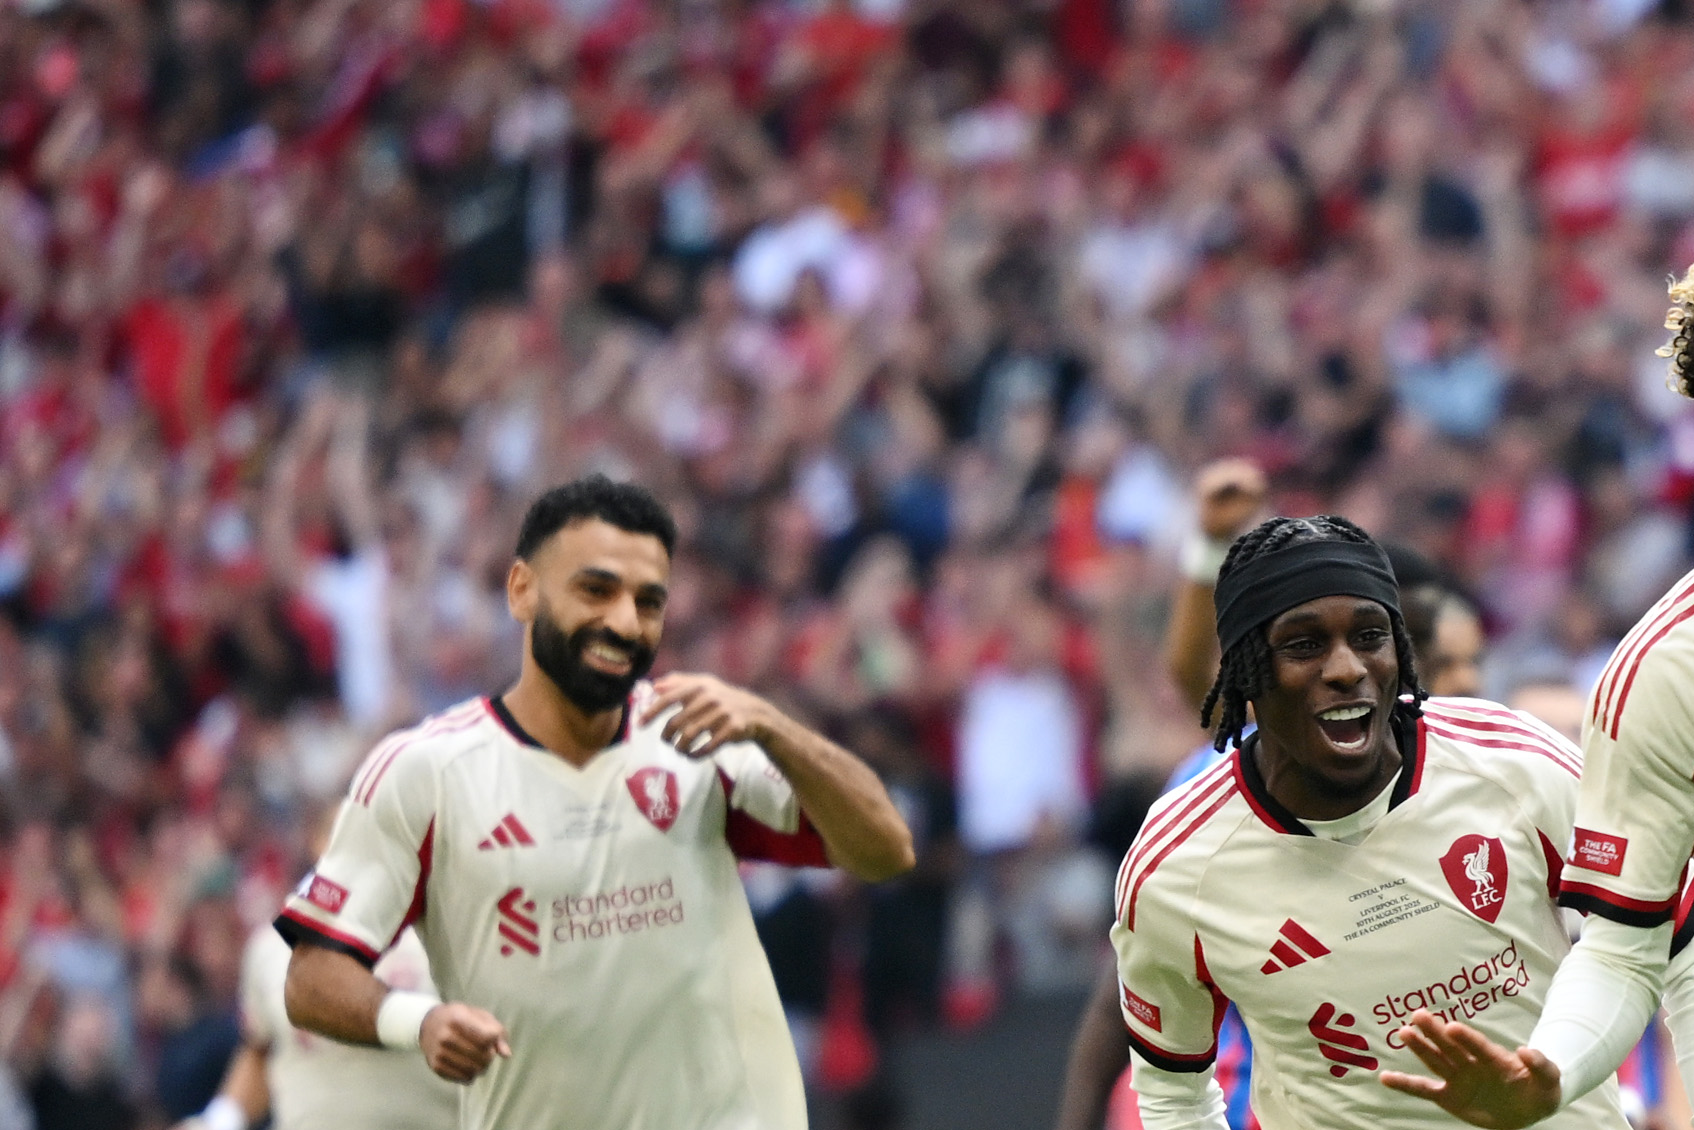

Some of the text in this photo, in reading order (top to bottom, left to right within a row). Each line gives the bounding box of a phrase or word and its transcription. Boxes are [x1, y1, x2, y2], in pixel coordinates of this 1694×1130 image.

[1601, 841, 1617, 854] FA
[552, 874, 675, 918] standard
[1348, 878, 1408, 903] CRYSTAL PALACE
[1360, 893, 1410, 917] LIVERPOOL FC
[1375, 906, 1403, 921] AUGUST
[1404, 899, 1421, 911] 2025
[553, 901, 684, 943] chartered
[1343, 901, 1441, 942] THE FA COMMUNITY SHIELD
[1373, 939, 1518, 1025] standard
[1386, 960, 1530, 1050] crtered
